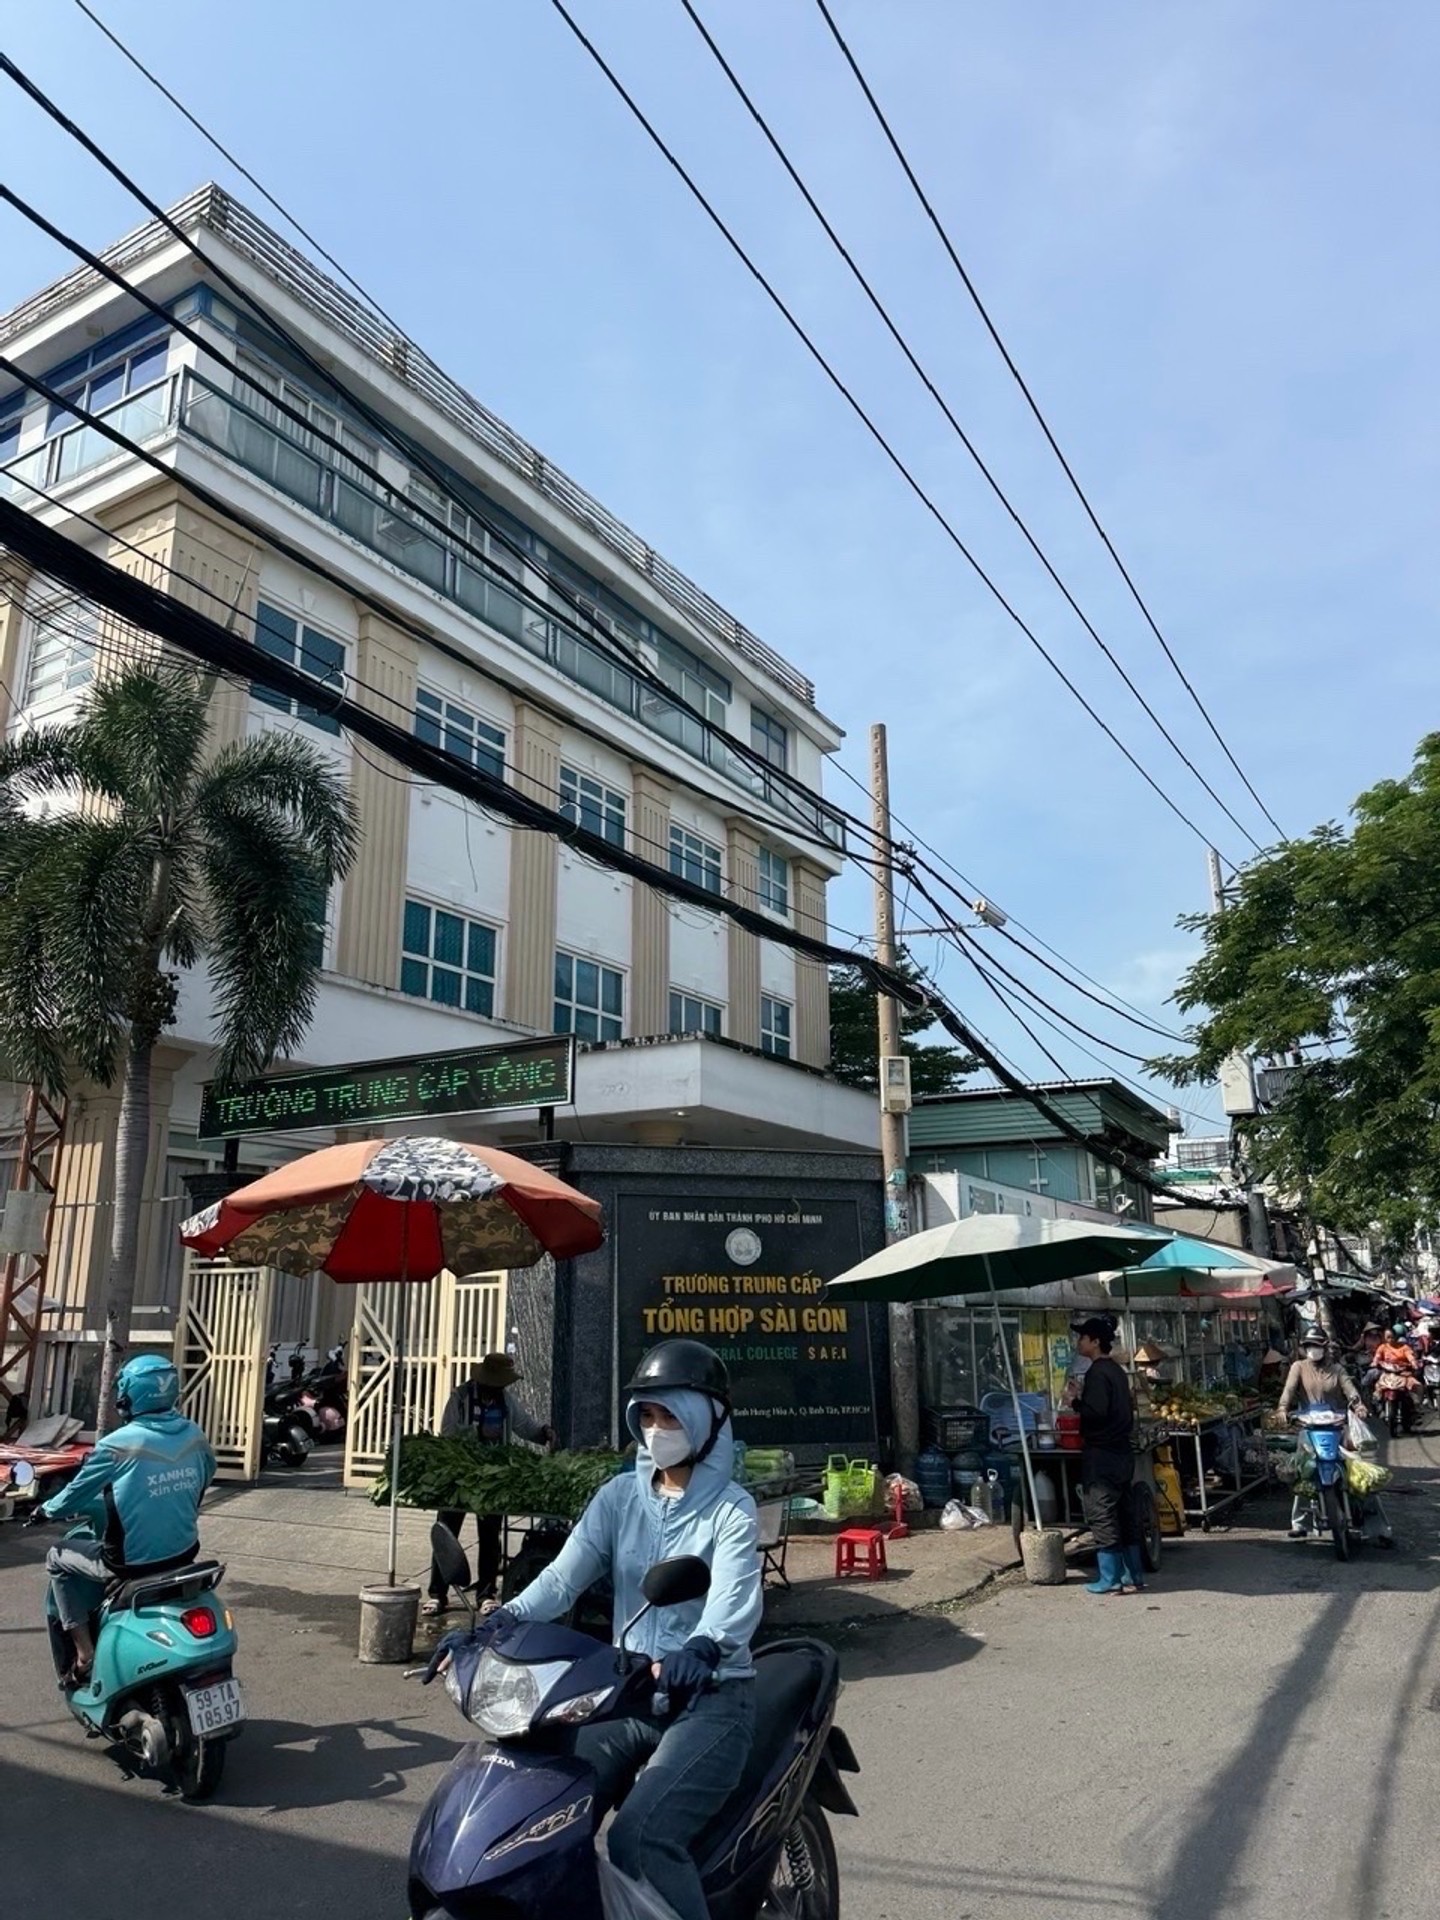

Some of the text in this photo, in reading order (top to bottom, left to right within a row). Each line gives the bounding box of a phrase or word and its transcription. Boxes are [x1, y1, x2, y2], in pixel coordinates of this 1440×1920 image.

[323, 1077, 410, 1110] TRUNG
[662, 1211, 681, 1221] BAN
[802, 1214, 823, 1225] MINH
[732, 1275, 788, 1294] TRUNG
[790, 1268, 823, 1295] CẤP
[642, 1297, 706, 1334] TỔNG
[709, 1303, 755, 1339] HỢP
[759, 1301, 798, 1334] SÀI
[746, 1346, 799, 1361] COLLEGE
[195, 1683, 235, 1710] 59-TA
[196, 1699, 240, 1731] 185.97
